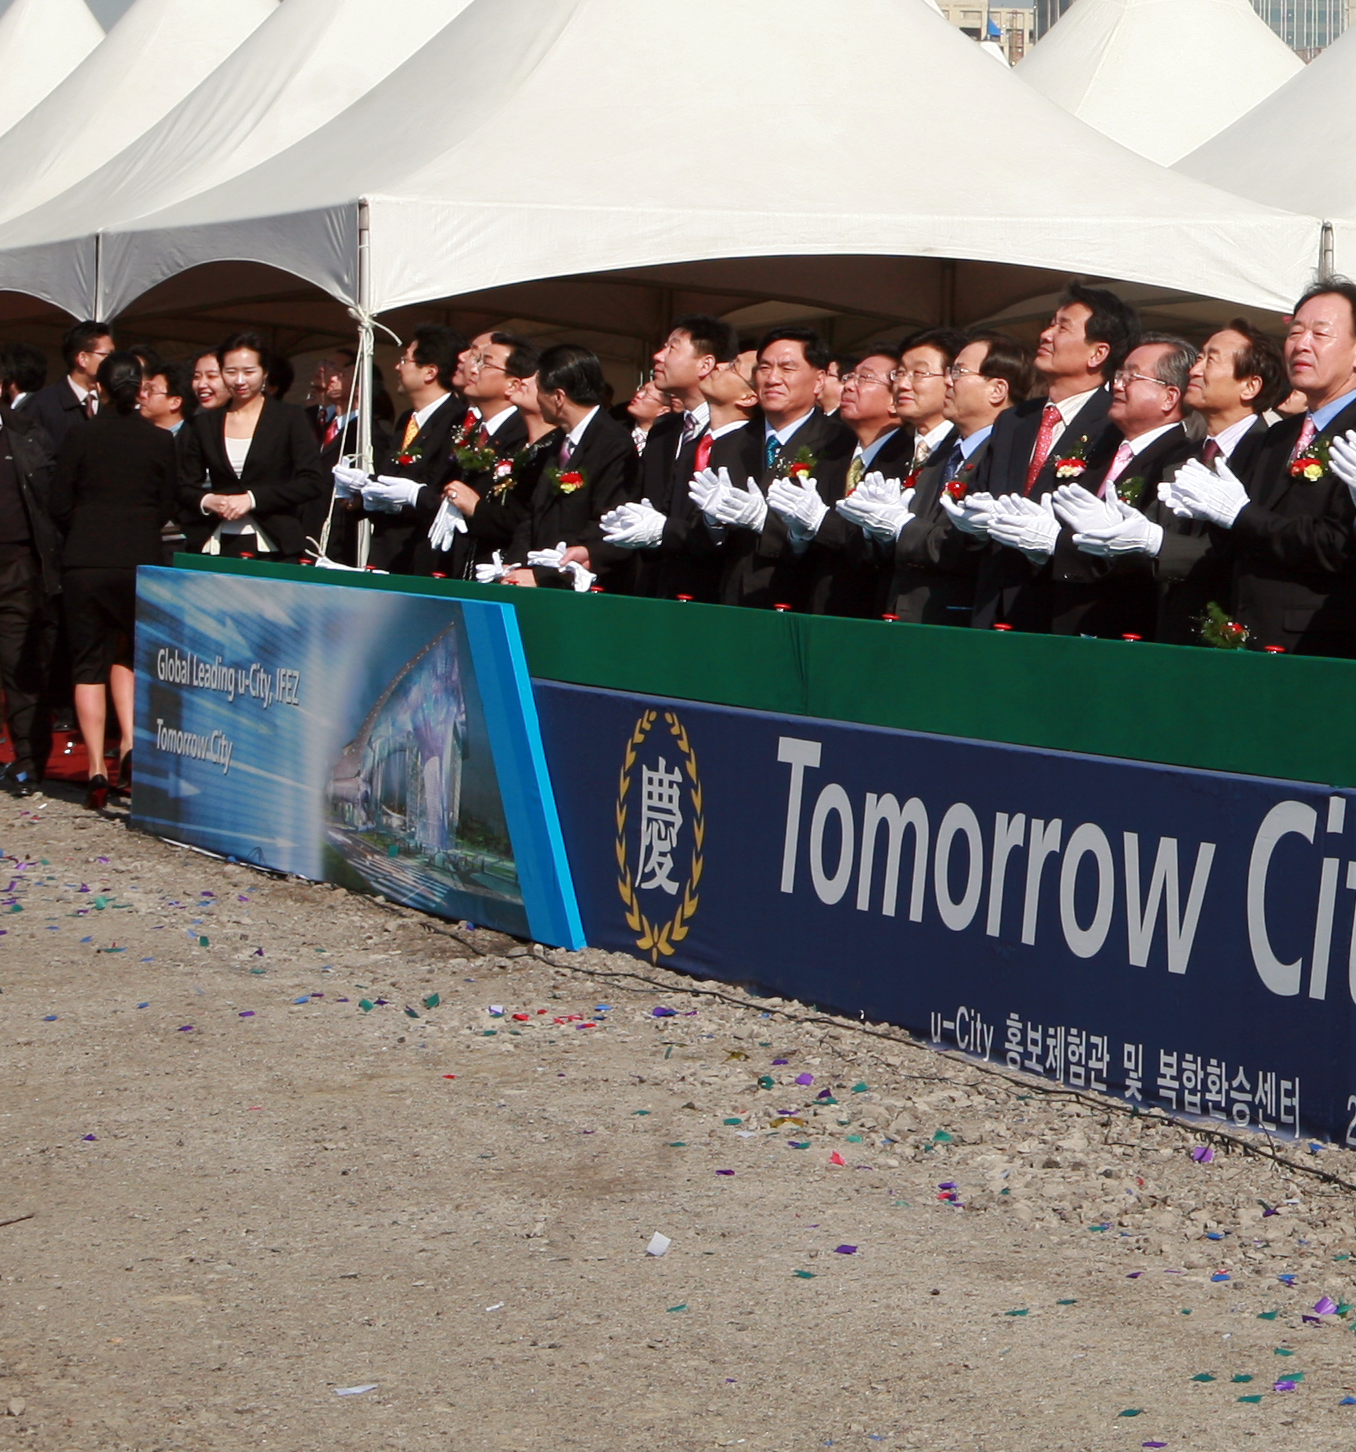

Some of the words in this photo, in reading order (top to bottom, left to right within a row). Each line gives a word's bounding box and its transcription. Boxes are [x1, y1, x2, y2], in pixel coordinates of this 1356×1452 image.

[157, 648, 191, 685] Global
[193, 655, 236, 703] Leading
[238, 663, 273, 709] u-City,
[276, 668, 300, 706] IFEZ
[156, 718, 209, 761] Tomorrow
[210, 729, 234, 775] City
[634, 756, 685, 897] 慶
[777, 736, 1216, 975] Tomorrow
[930, 1005, 994, 1061] u-City
[1004, 1012, 1110, 1092] 홍보체험관
[1123, 1043, 1143, 1101] 및
[1156, 1048, 1300, 1139] 복합환승센터
